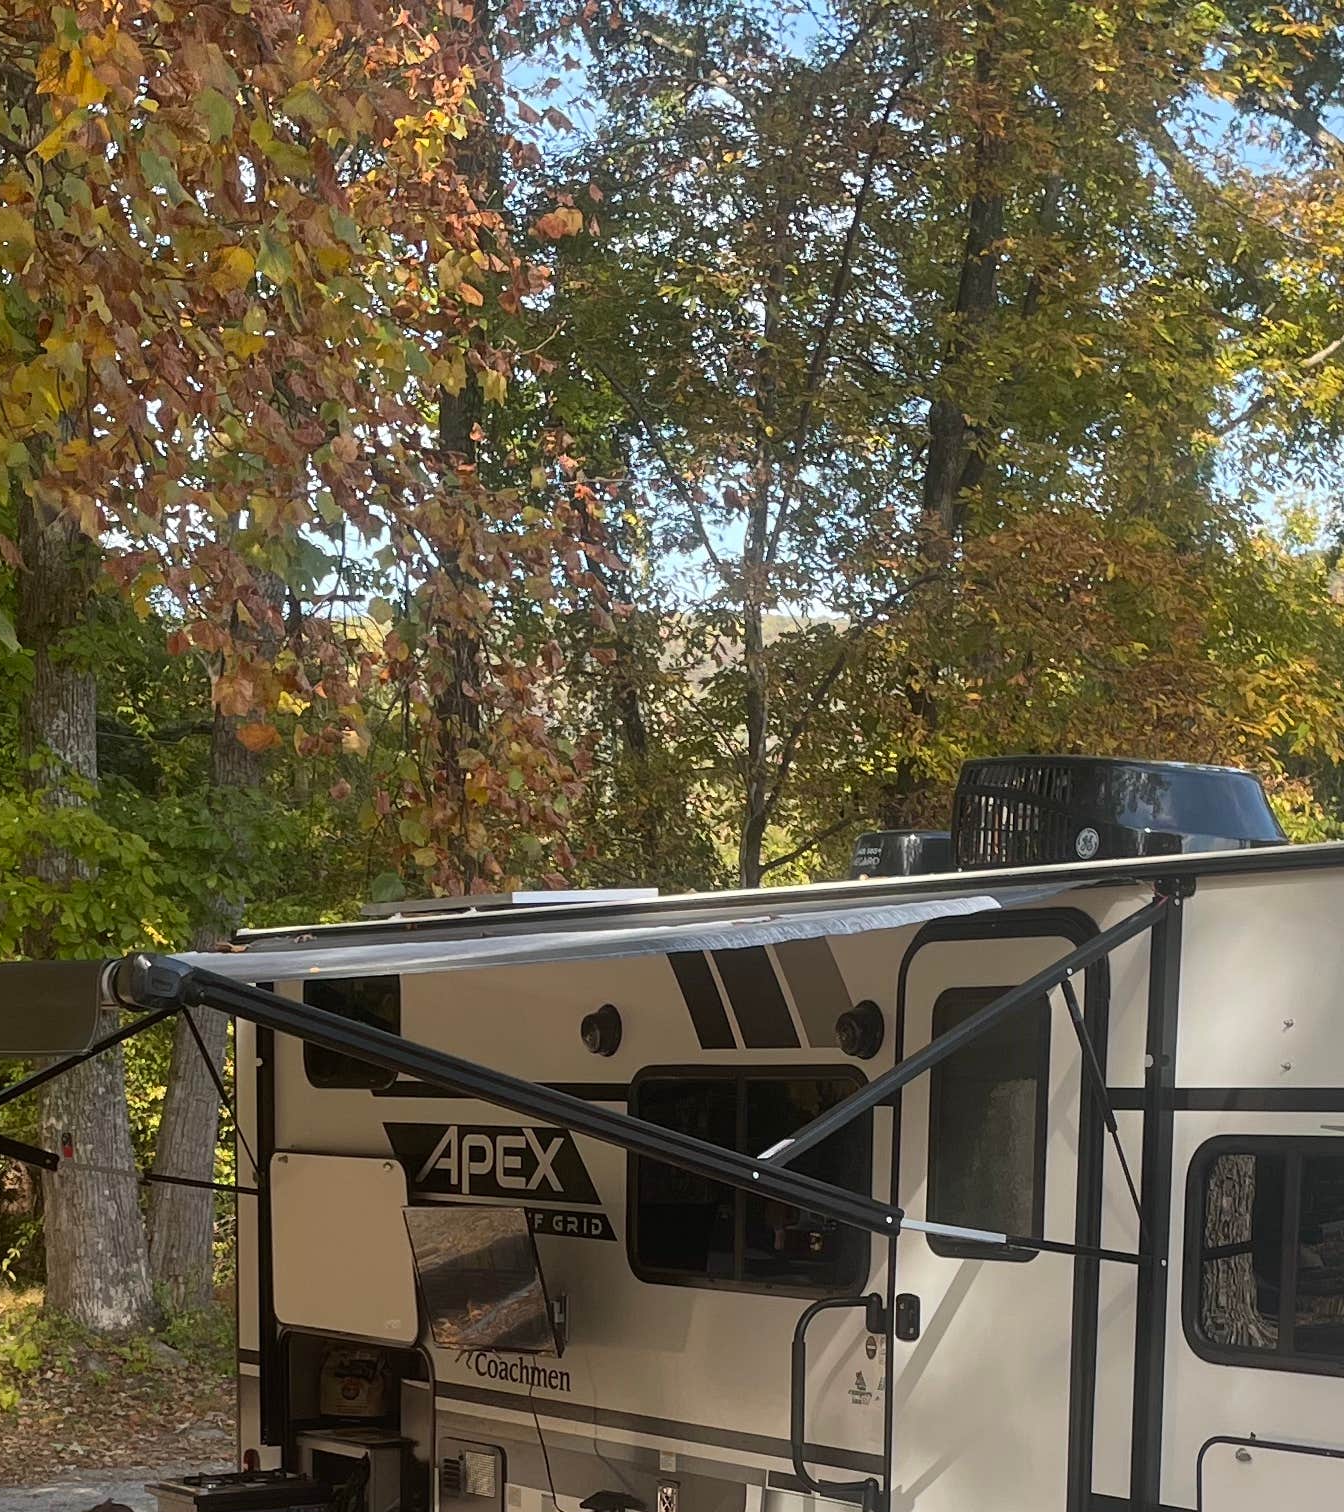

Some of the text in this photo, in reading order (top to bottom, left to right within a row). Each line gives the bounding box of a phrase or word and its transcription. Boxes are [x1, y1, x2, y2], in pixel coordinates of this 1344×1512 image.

[415, 1125, 565, 1195] APEX
[552, 1215, 603, 1235] GRID
[475, 1351, 571, 1392] Coachmen
